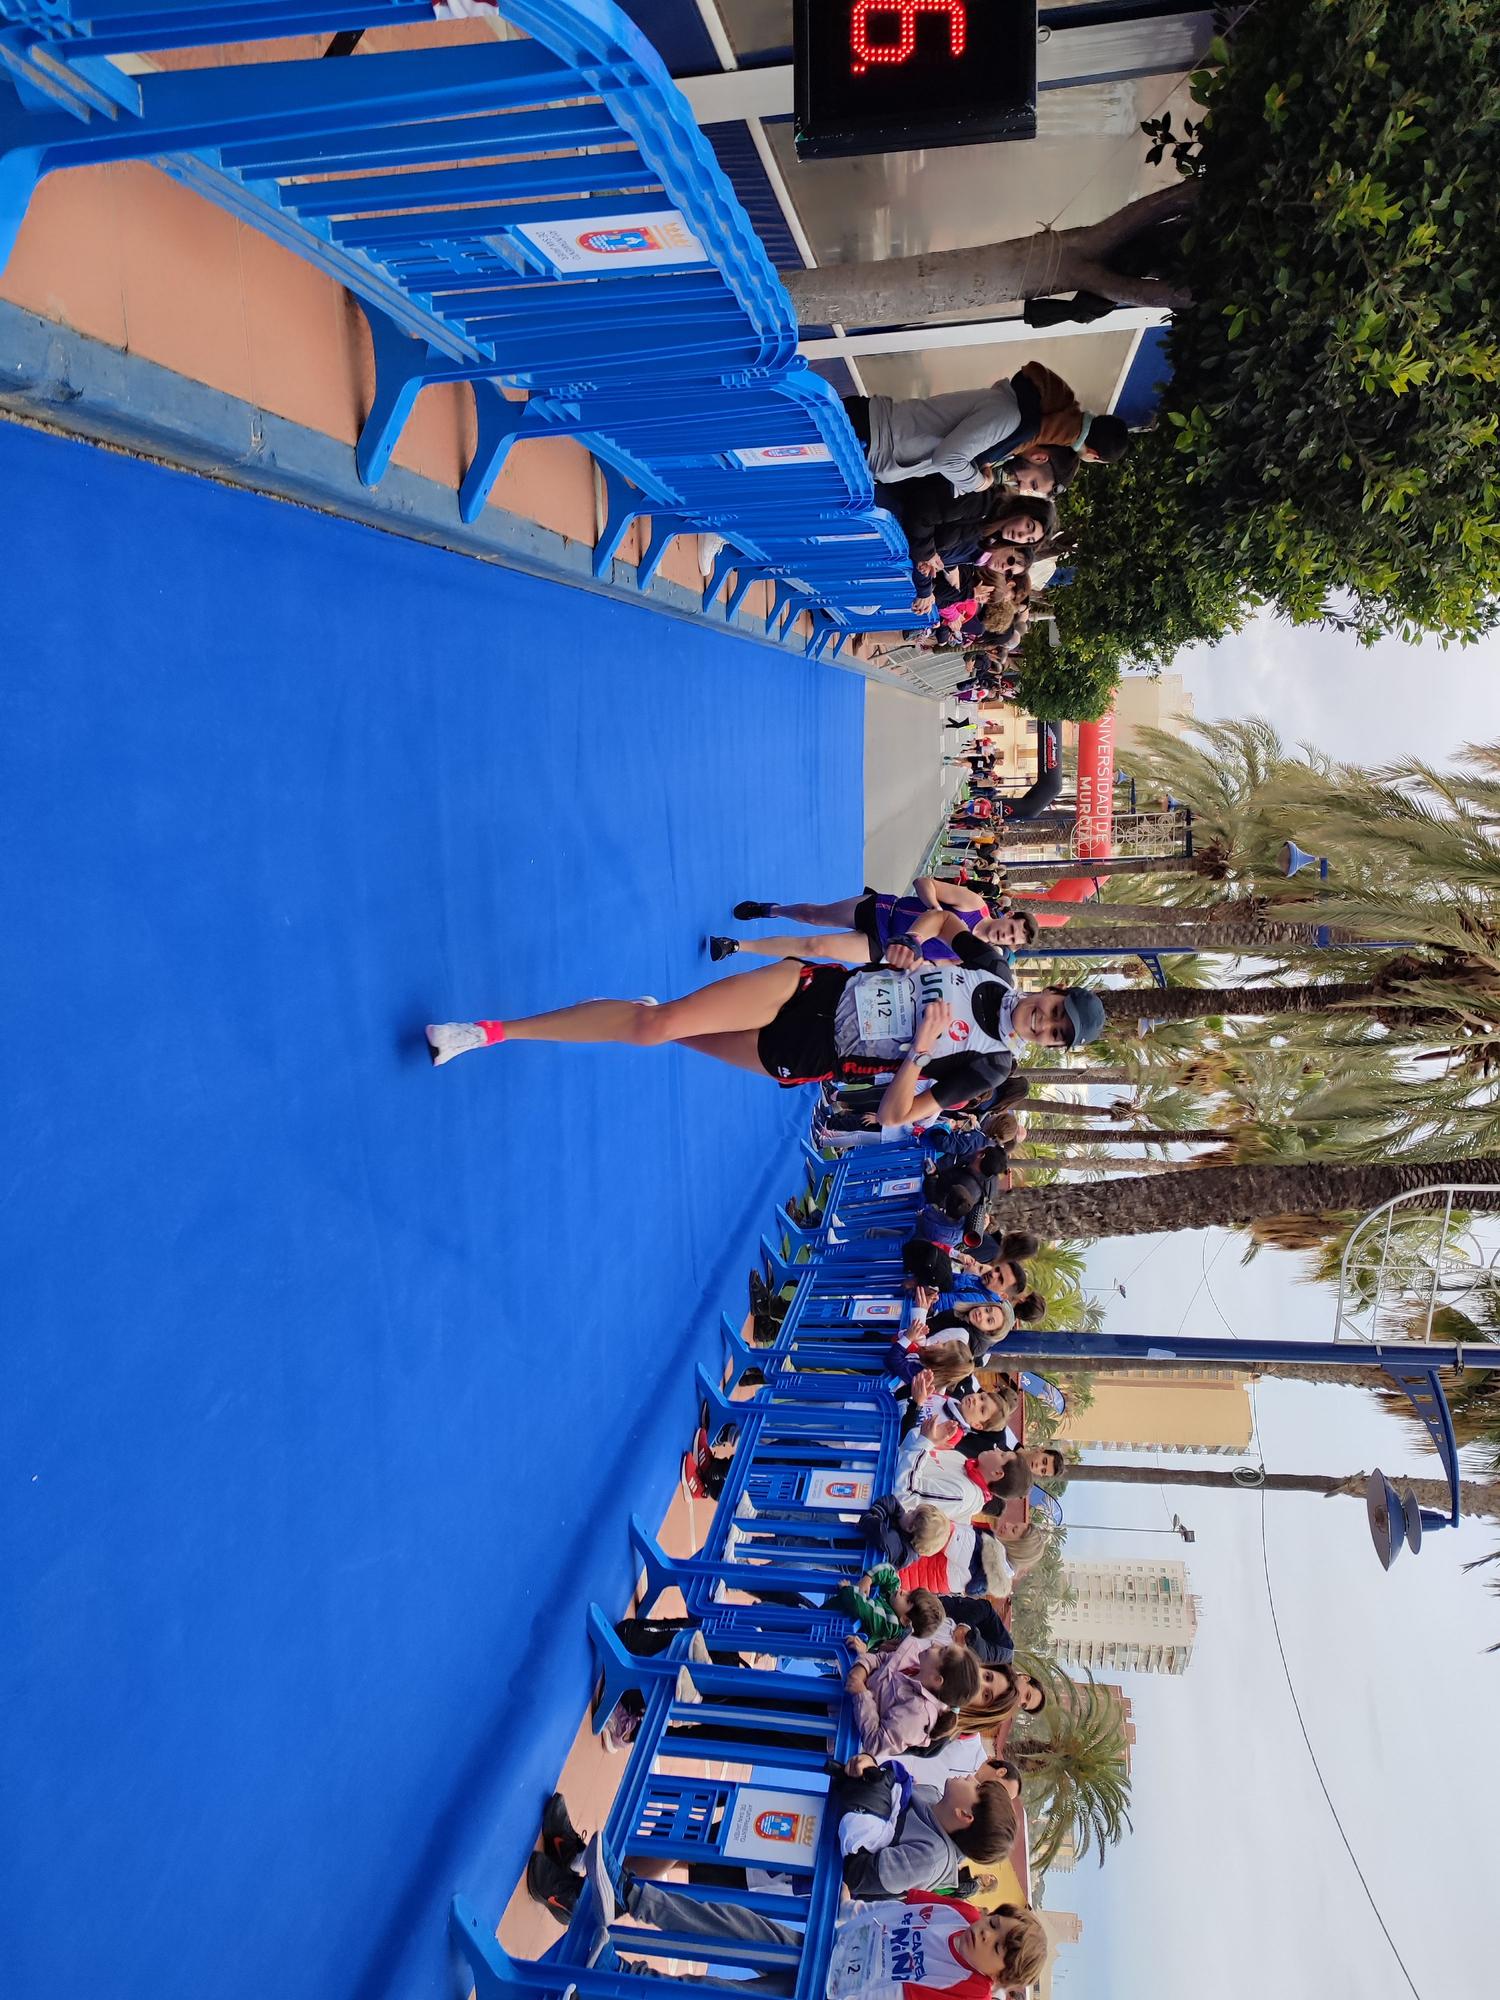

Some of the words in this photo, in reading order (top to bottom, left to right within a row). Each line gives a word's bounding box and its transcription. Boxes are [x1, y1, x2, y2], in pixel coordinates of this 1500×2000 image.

[1096, 716, 1112, 816] NIVERSIDAD
[1079, 776, 1092, 841] MURCIA
[1096, 822, 1109, 843] DE
[876, 988, 892, 1018] 412
[847, 1946, 861, 1975] 12
